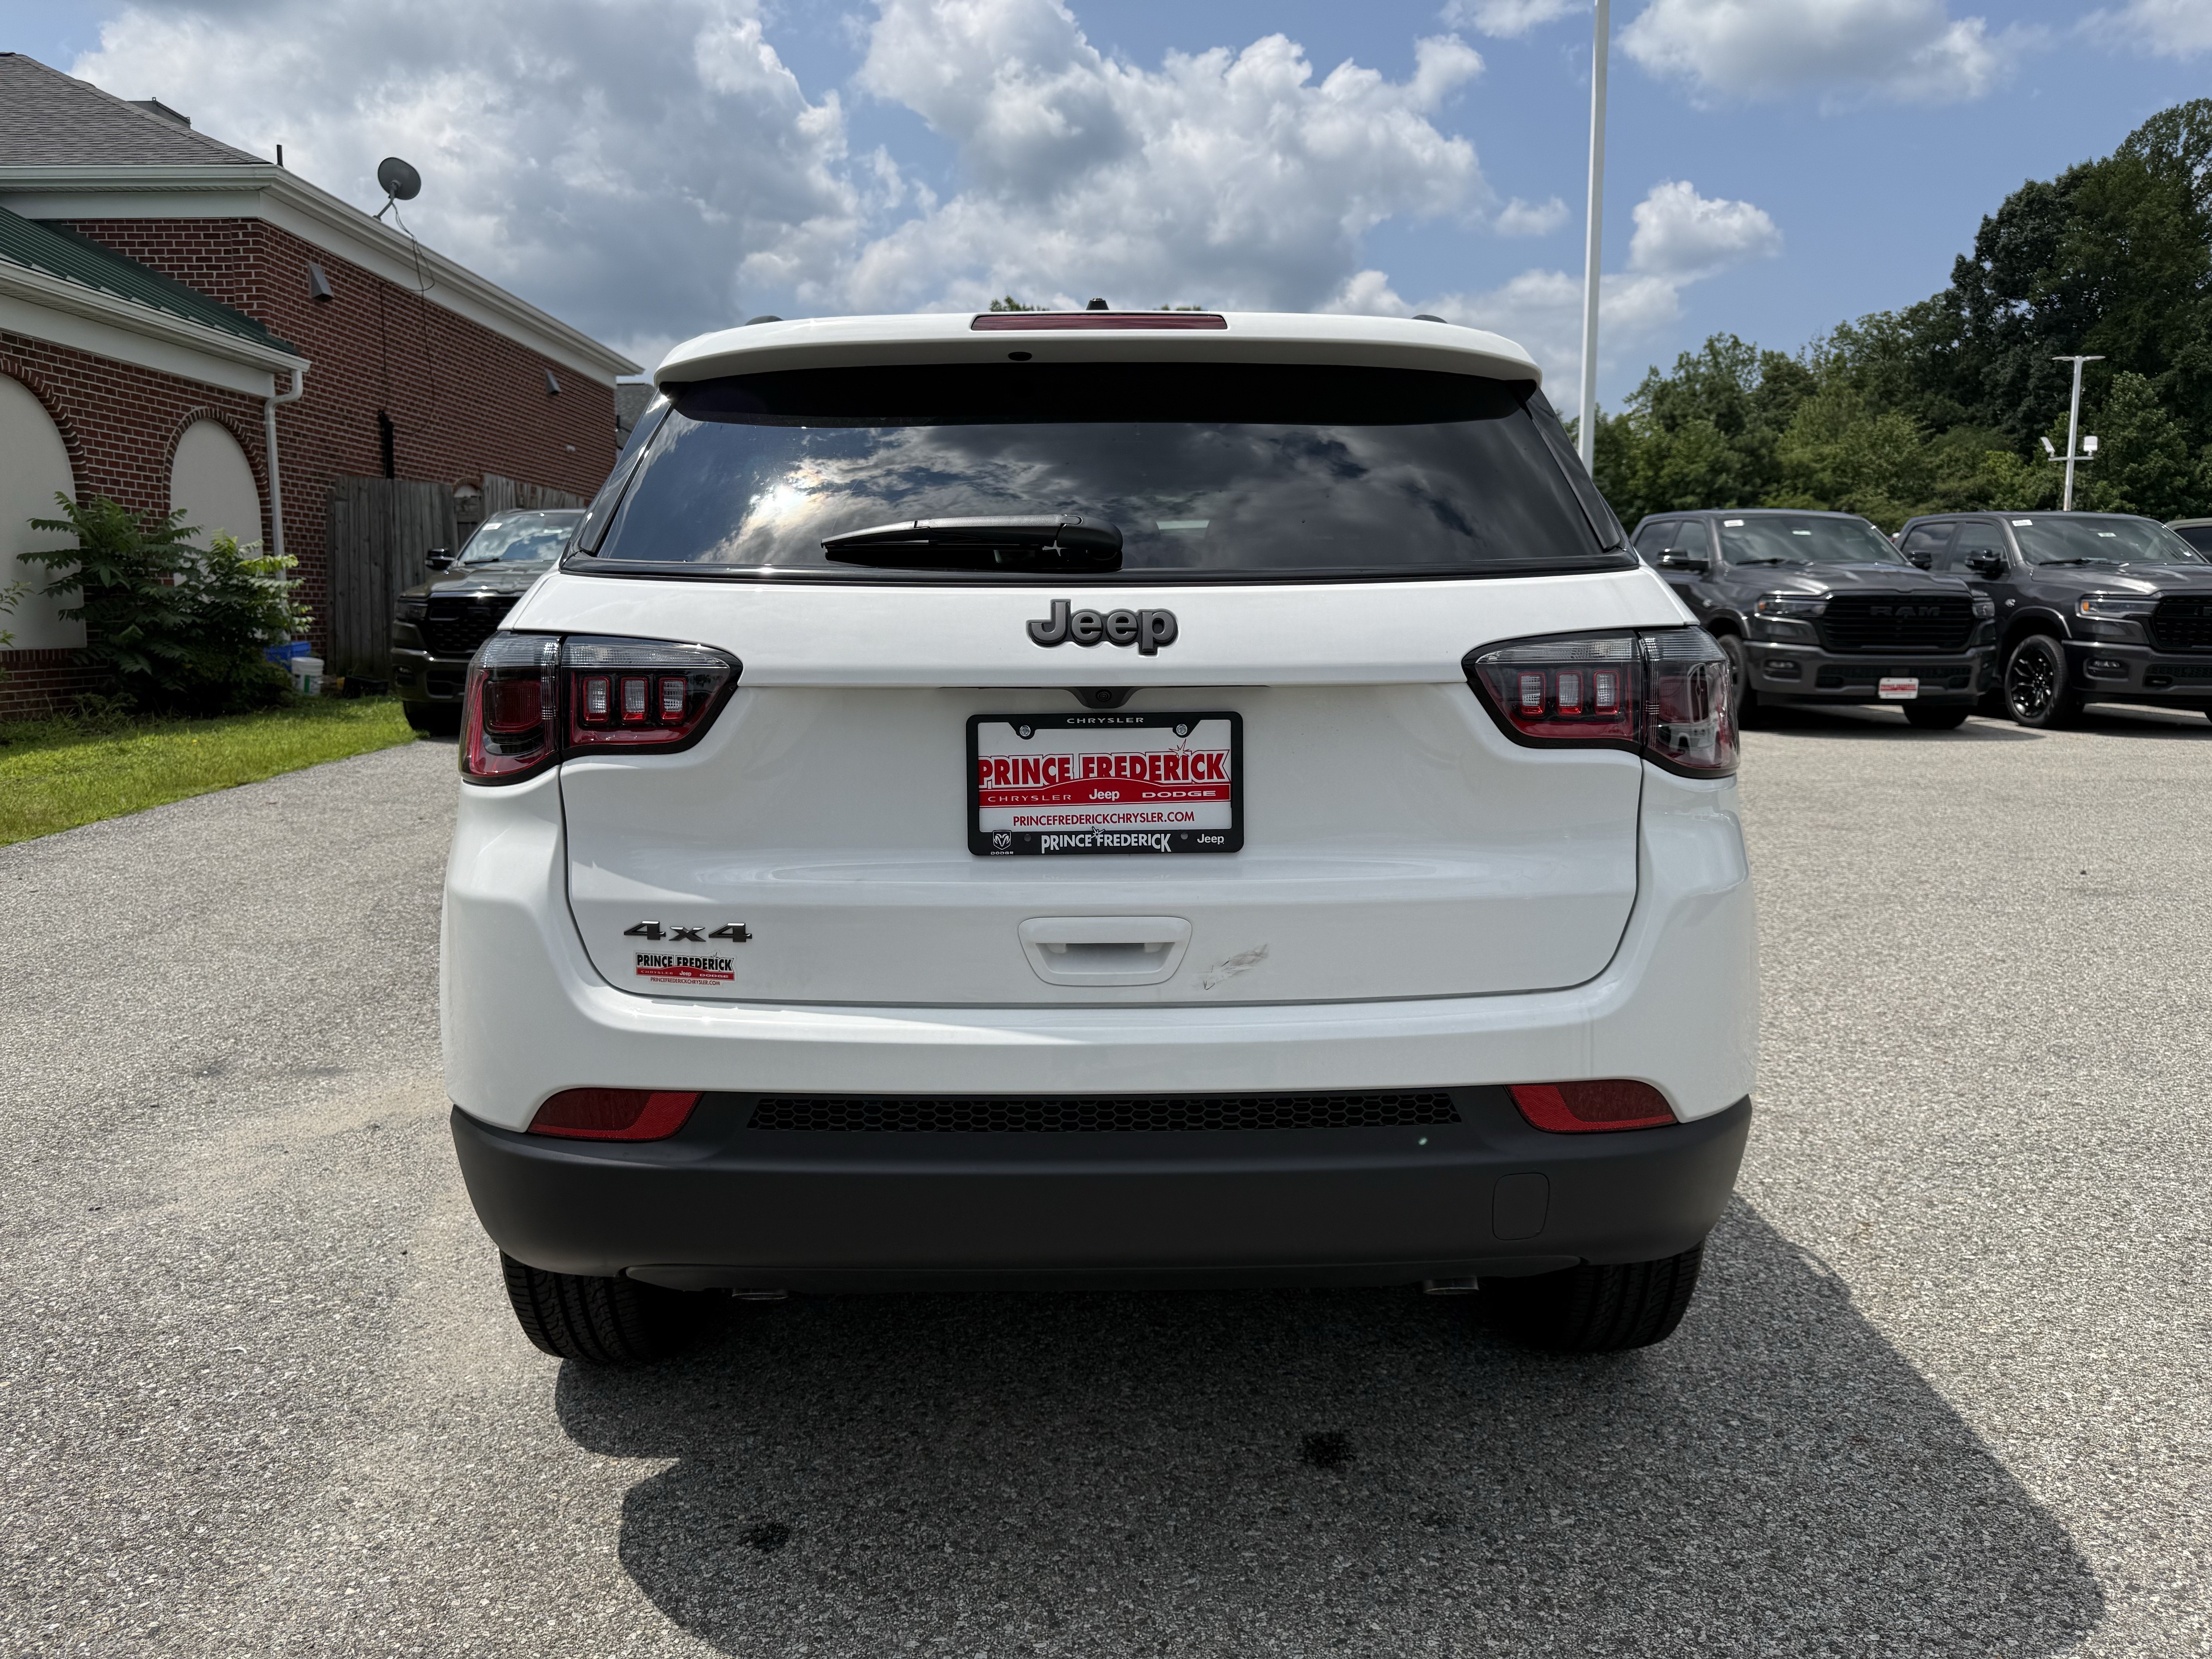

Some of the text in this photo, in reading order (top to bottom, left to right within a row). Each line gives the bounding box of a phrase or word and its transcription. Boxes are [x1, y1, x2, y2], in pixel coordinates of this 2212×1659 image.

[1870, 606, 1940, 616] RAM
[1027, 599, 1178, 655] Jeep
[979, 752, 1225, 785] PRINCE FREDERICK
[1089, 789, 1120, 801] Jeep
[1013, 811, 1195, 826] PRINCEFREDERICKCHRYSLER.COM
[1041, 833, 1171, 854] PRINCE FREDERICK
[1197, 834, 1224, 845] Jeep
[624, 921, 752, 942] 4x4
[637, 954, 732, 971] PRINCE FREDERICK
[651, 977, 720, 986] PRINCEFREDERICKCHRYSLER.COM
